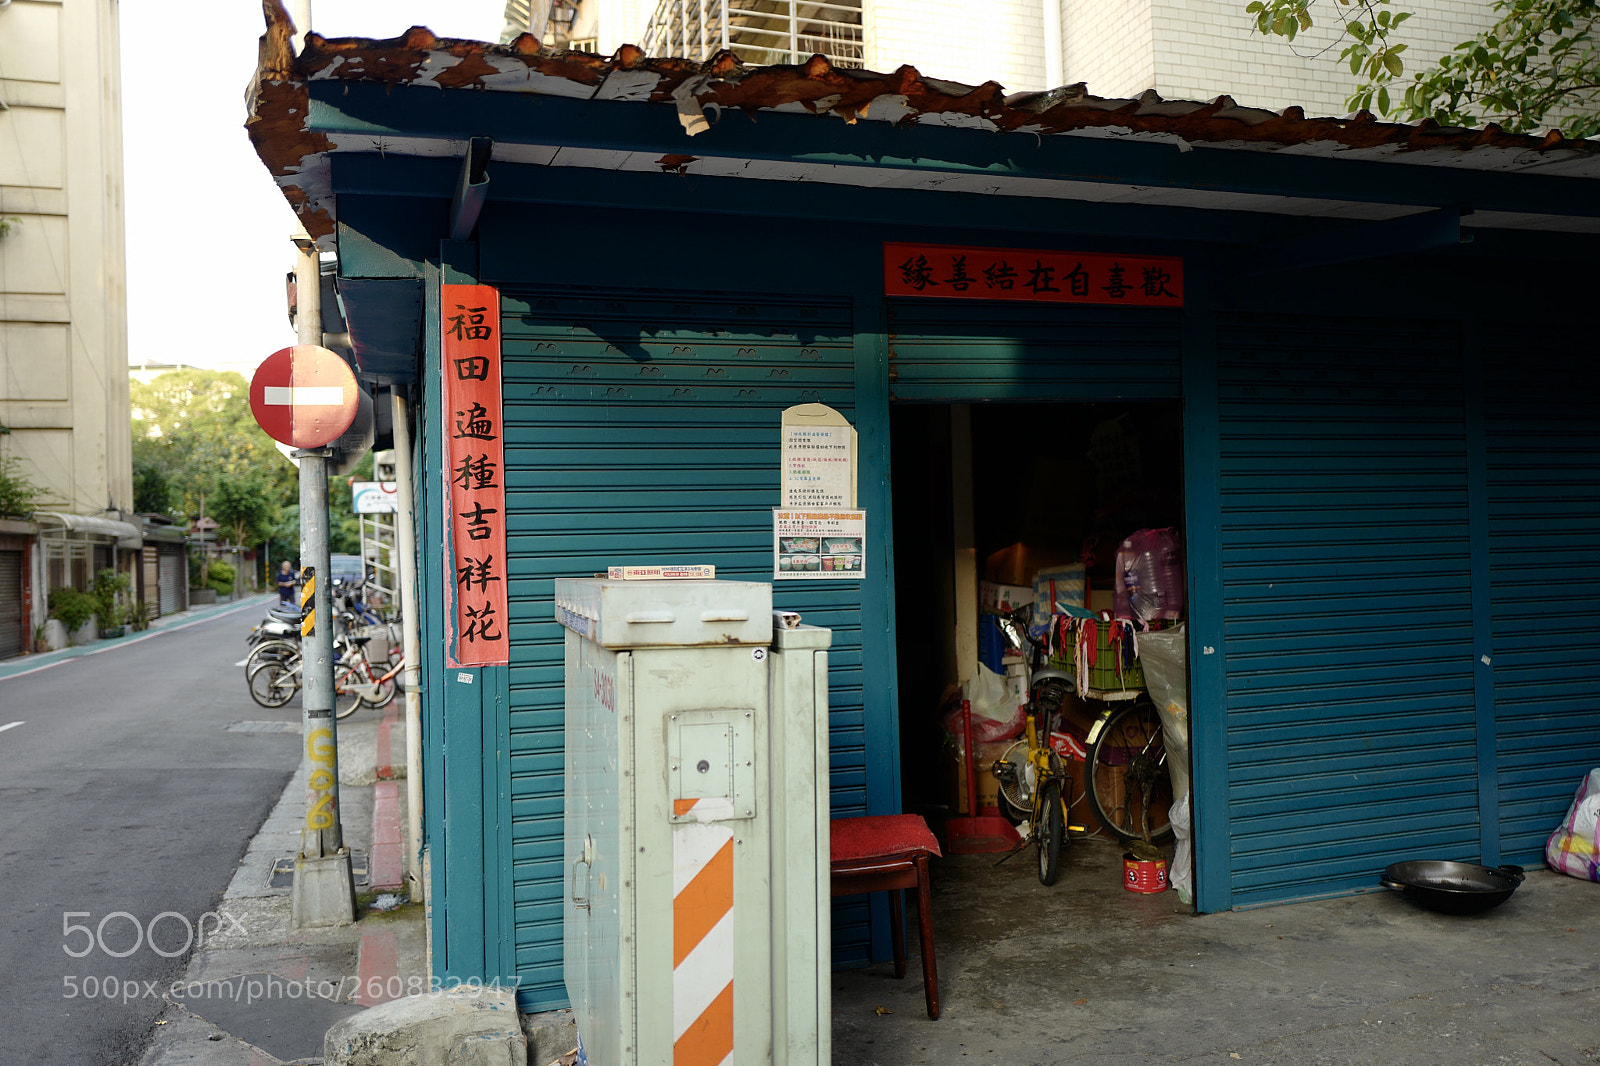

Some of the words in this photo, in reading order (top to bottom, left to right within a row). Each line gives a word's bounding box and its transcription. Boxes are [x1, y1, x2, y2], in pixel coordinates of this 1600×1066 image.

[446, 304, 502, 643] 福田遍種吉祥花
